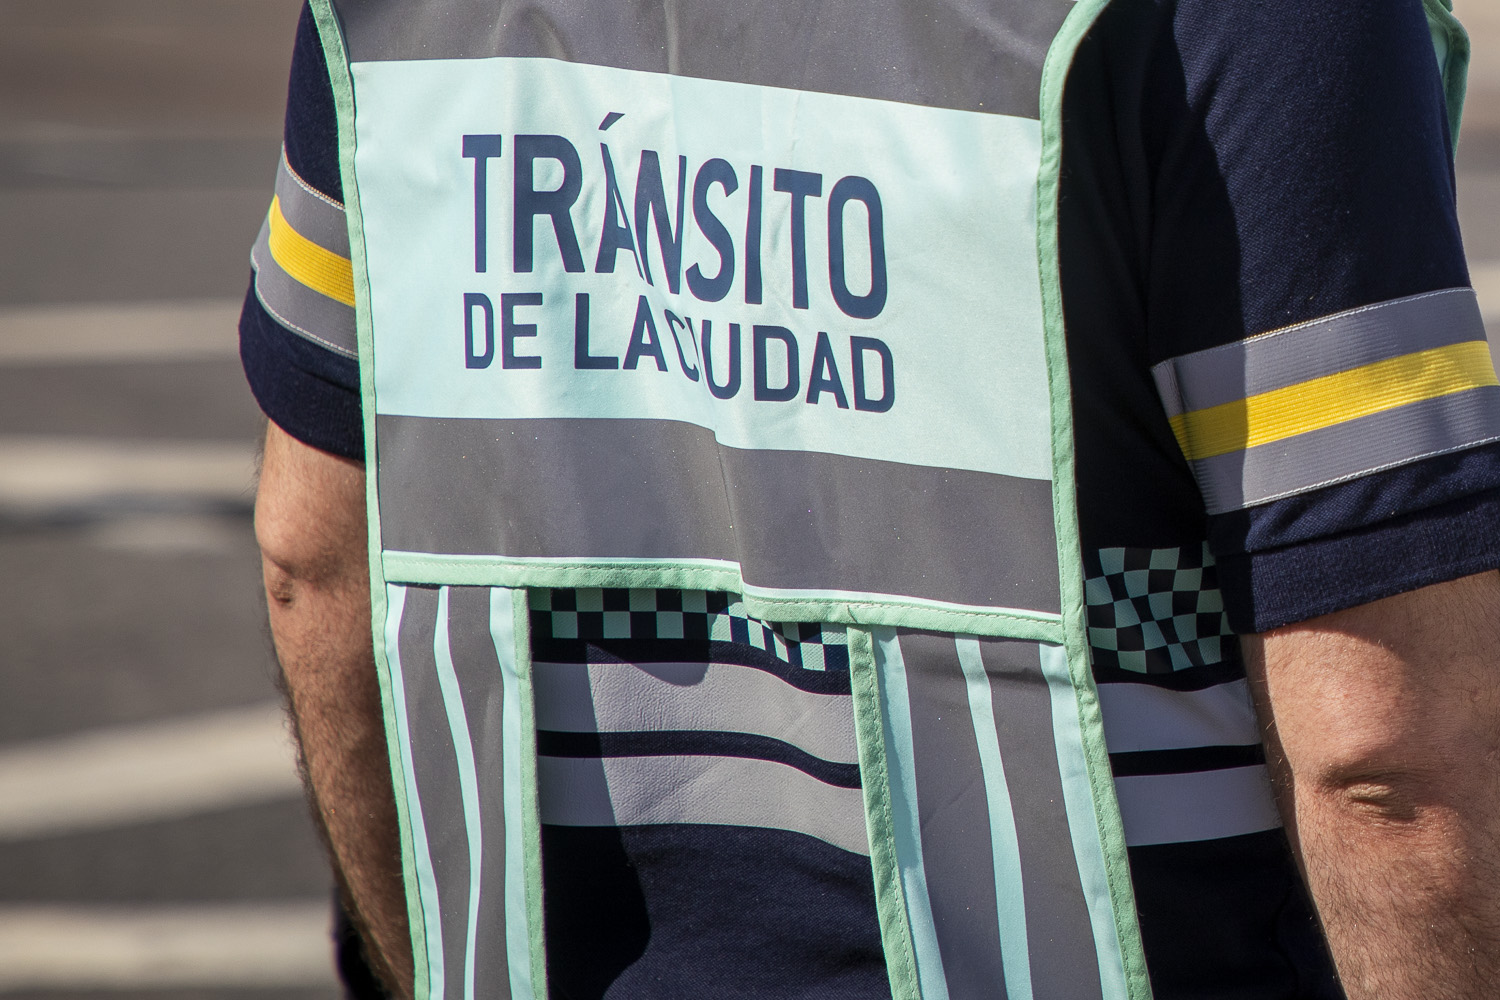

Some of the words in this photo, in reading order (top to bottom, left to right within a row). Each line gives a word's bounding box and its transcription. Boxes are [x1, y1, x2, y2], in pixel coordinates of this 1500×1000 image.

[462, 111, 888, 320] TRÁNSITO
[463, 293, 543, 370] DE
[574, 293, 668, 372] LA
[664, 308, 895, 414] CIUDAD
